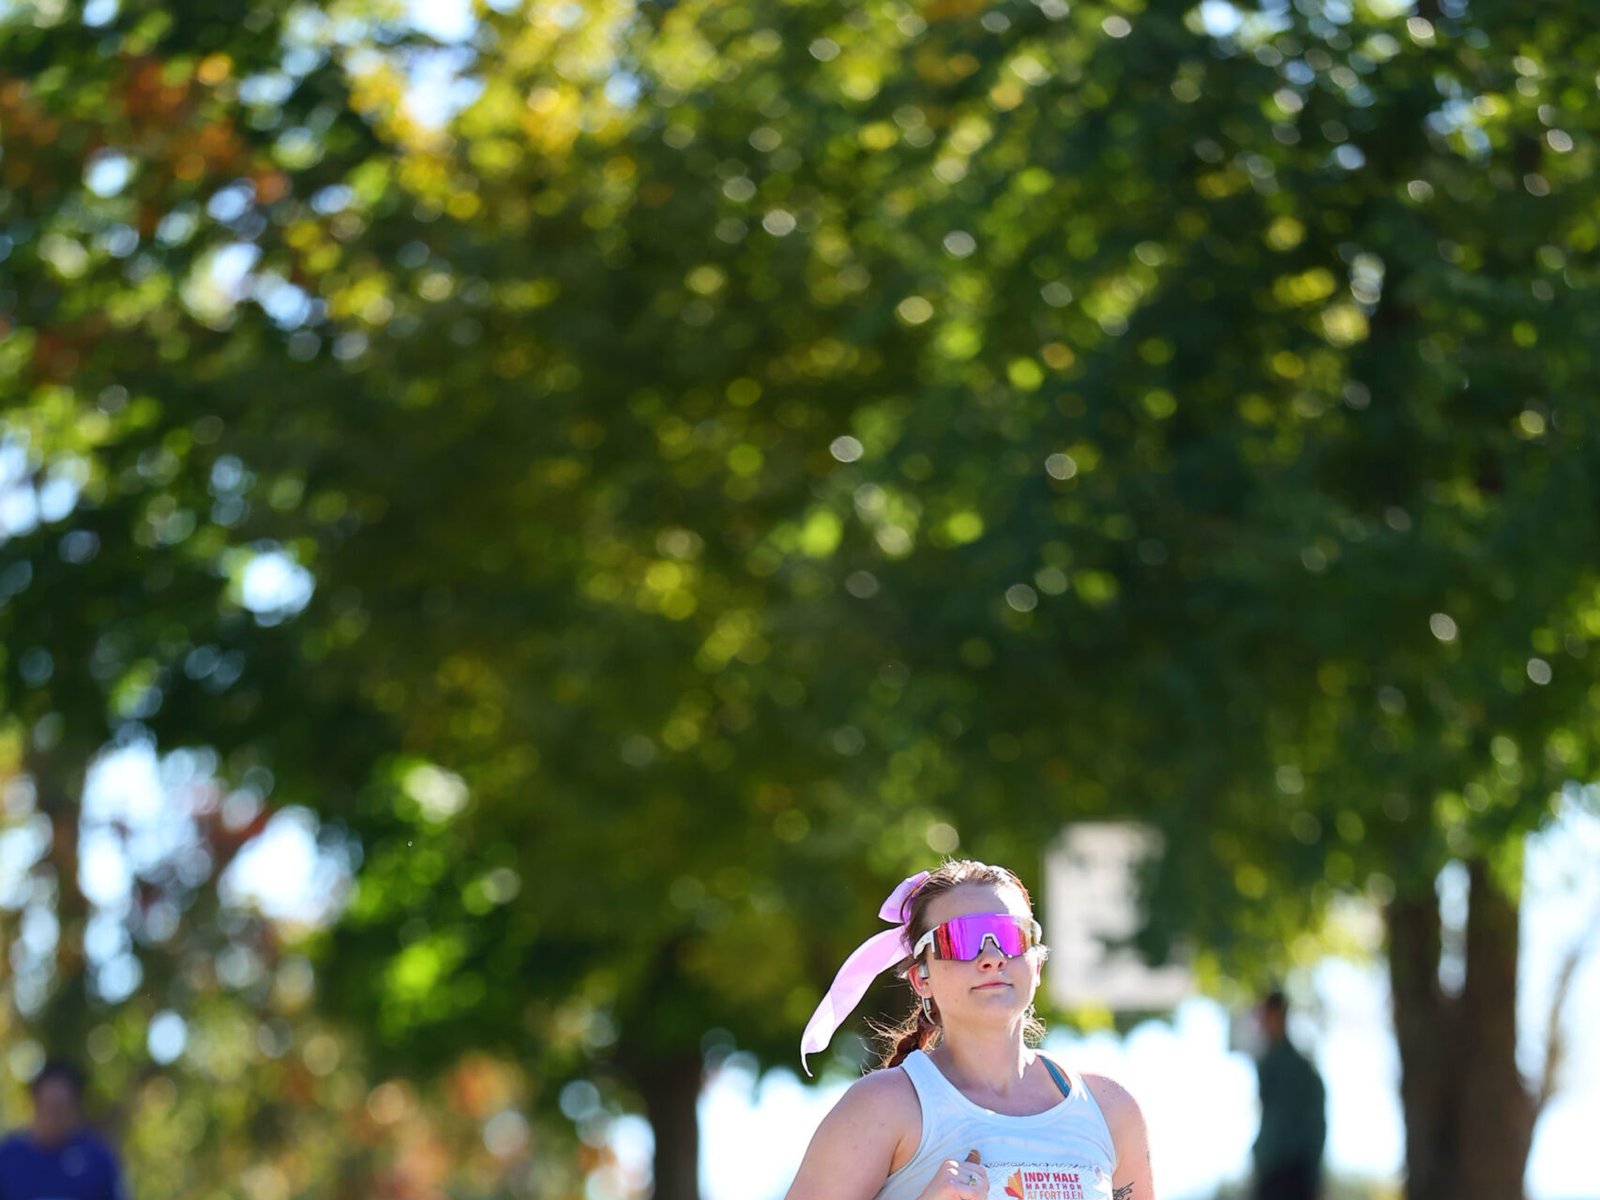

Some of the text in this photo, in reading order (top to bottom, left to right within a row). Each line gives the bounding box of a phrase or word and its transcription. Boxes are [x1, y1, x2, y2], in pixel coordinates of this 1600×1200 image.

[1024, 1172, 1080, 1183] INDY HALF
[1026, 1183, 1082, 1191] MARATHON
[1027, 1191, 1037, 1200] AT
[1039, 1191, 1060, 1200] FORT
